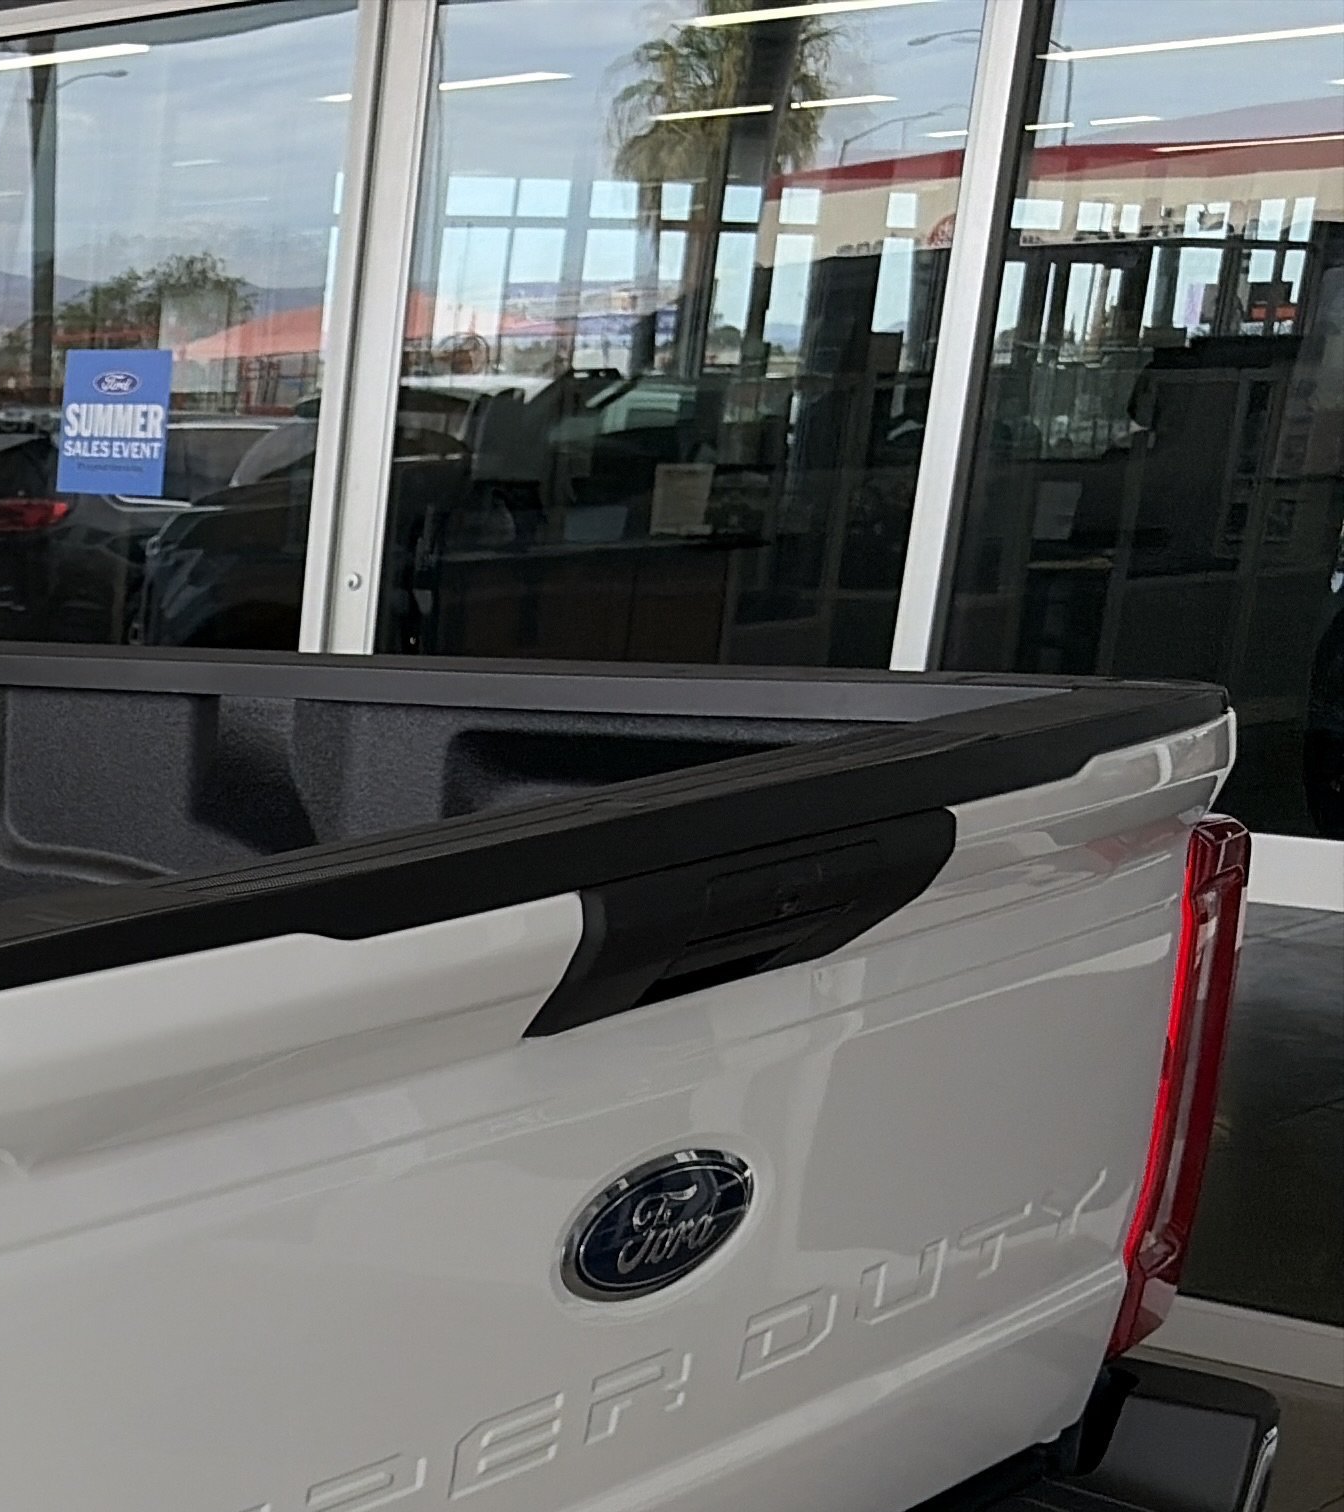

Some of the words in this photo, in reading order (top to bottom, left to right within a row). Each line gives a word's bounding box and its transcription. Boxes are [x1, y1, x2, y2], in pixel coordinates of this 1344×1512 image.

[64, 403, 164, 438] SUMMER
[63, 440, 110, 458] SALES
[112, 441, 162, 460] EVENT
[738, 1167, 1108, 1381] DUTY
